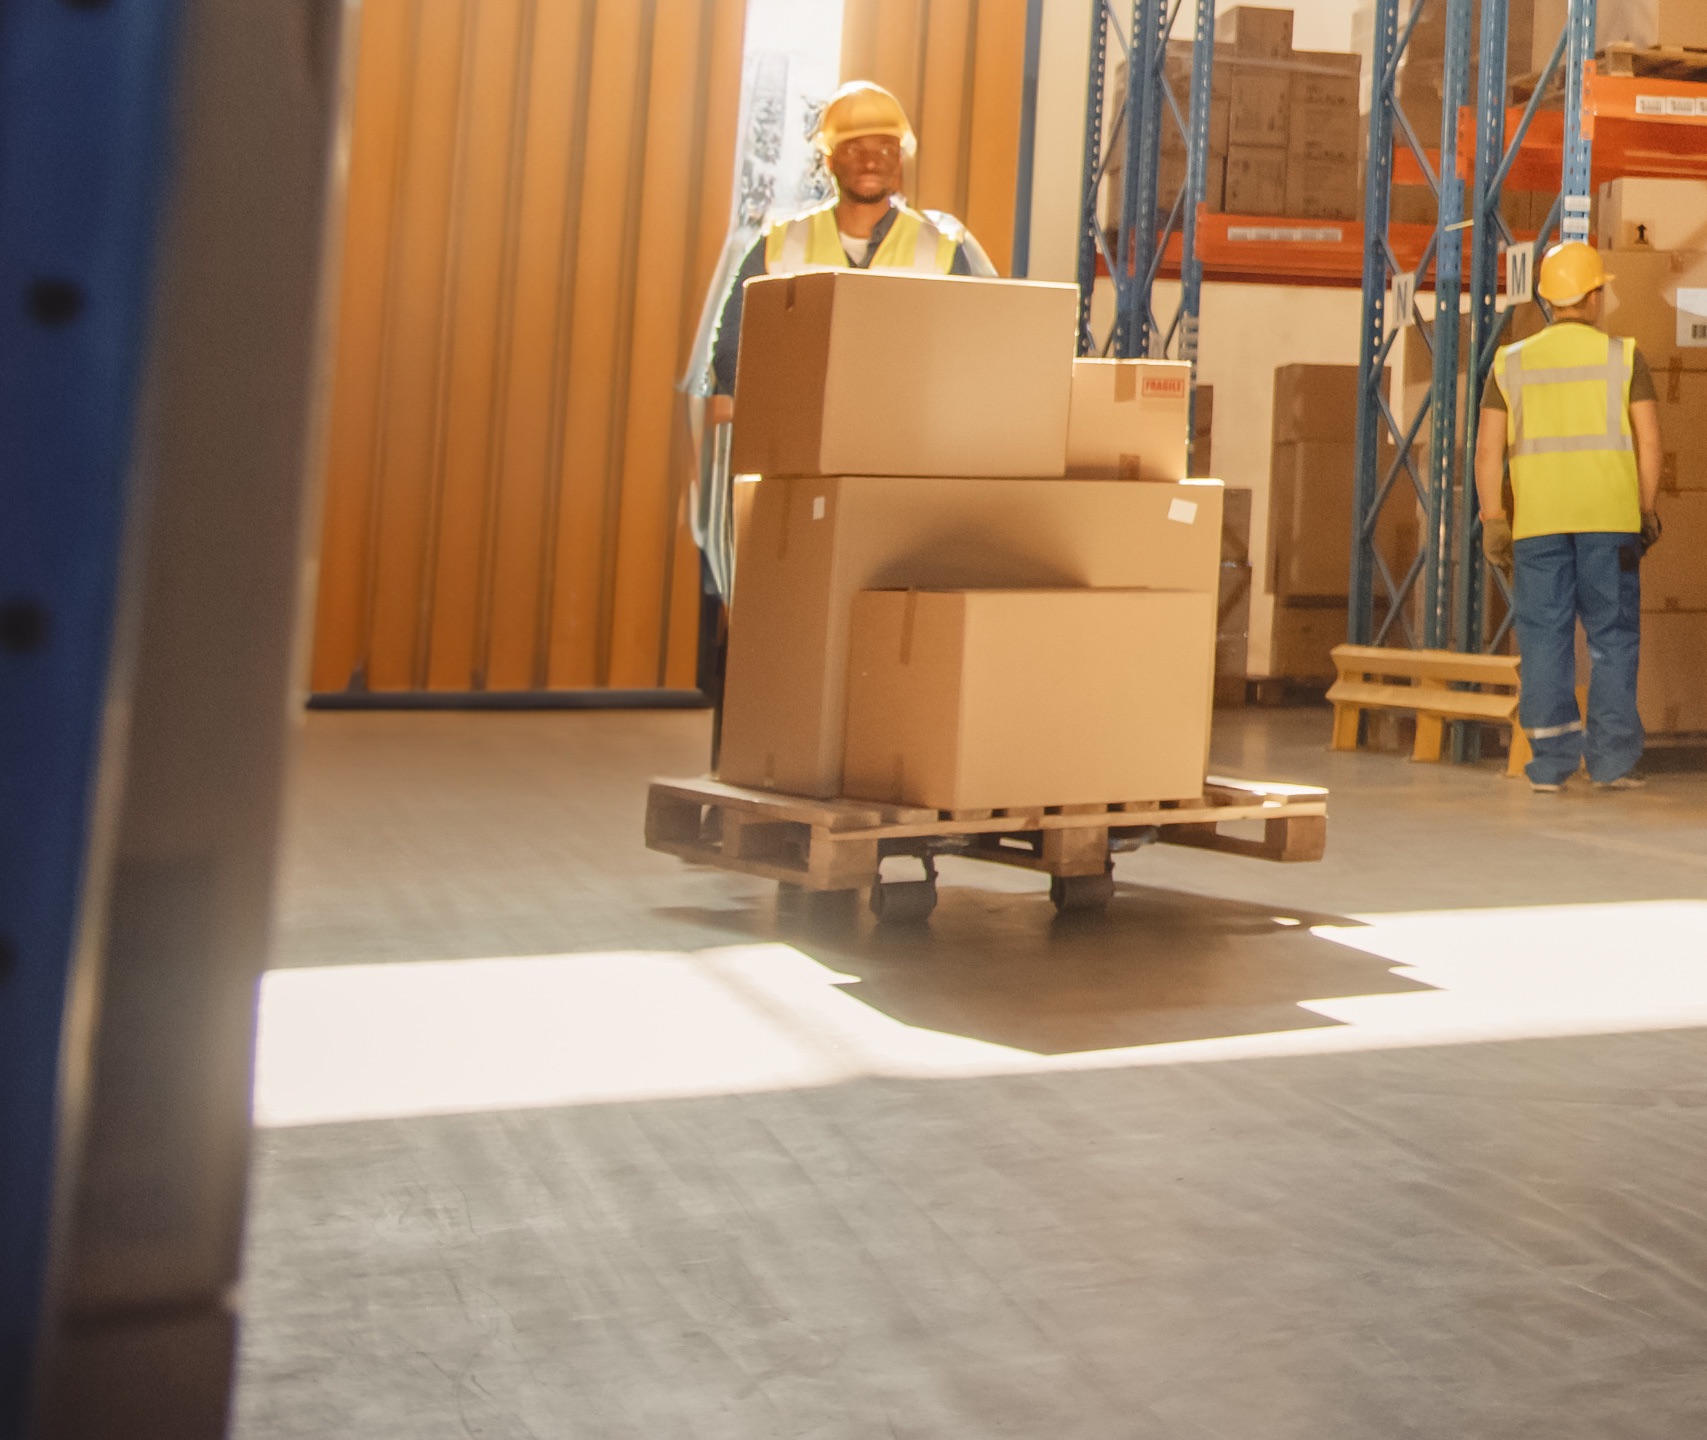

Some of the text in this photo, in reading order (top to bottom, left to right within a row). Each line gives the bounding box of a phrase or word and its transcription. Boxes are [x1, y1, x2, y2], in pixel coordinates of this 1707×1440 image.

[1512, 252, 1526, 297] M
[1396, 281, 1408, 322] N
[1145, 380, 1181, 392] FRAGILE
